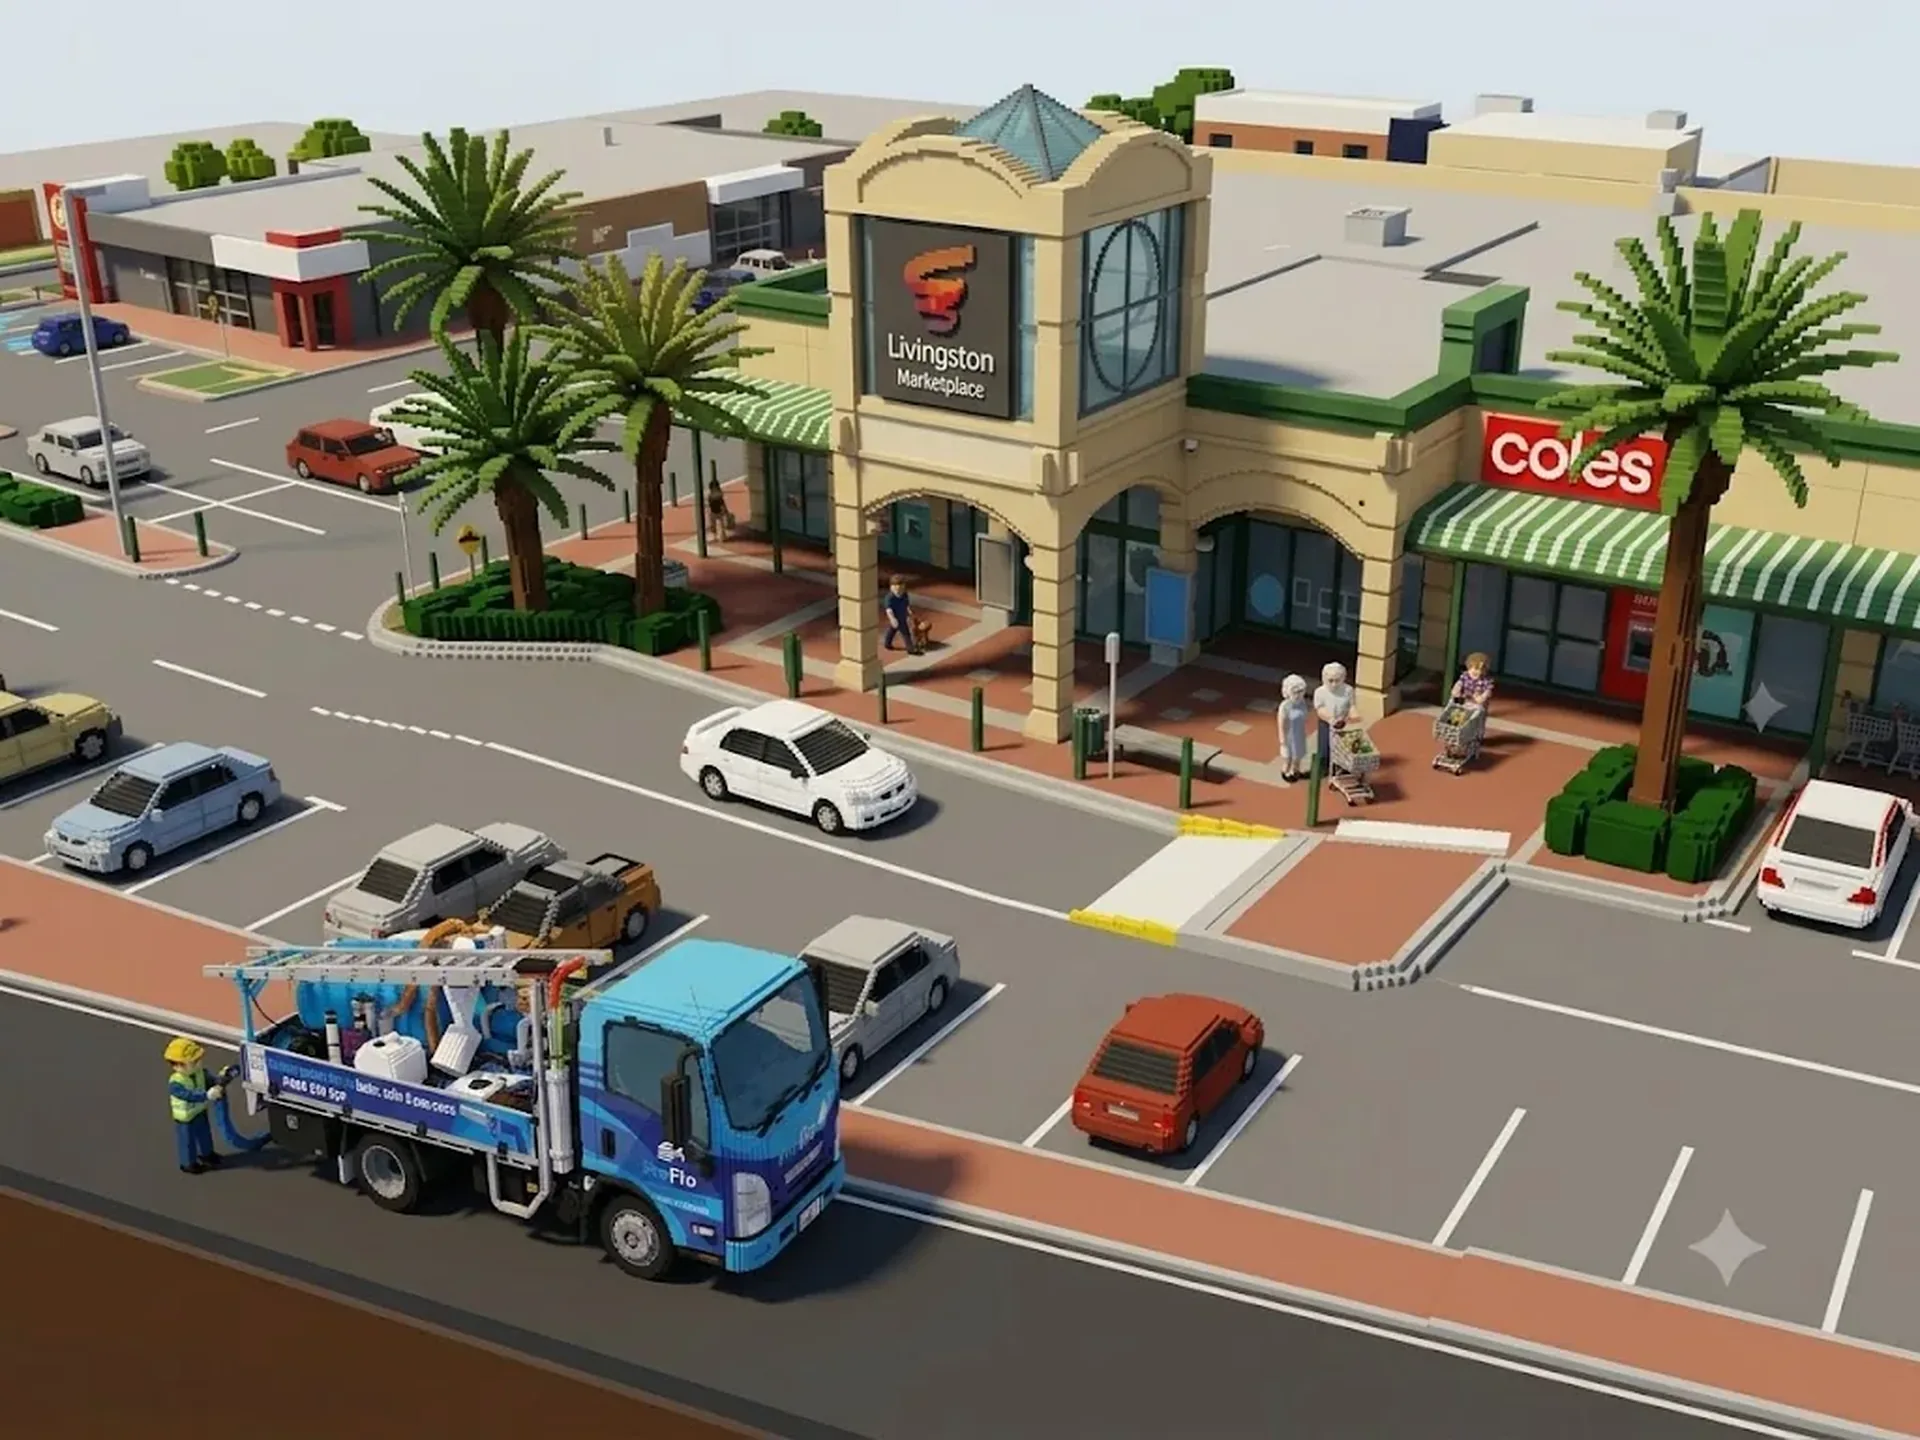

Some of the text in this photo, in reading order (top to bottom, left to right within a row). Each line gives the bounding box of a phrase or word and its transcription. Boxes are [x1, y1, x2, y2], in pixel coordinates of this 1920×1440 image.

[888, 332, 995, 373] Livingston
[897, 367, 986, 399] Marketplace
[1491, 429, 1653, 494] coles
